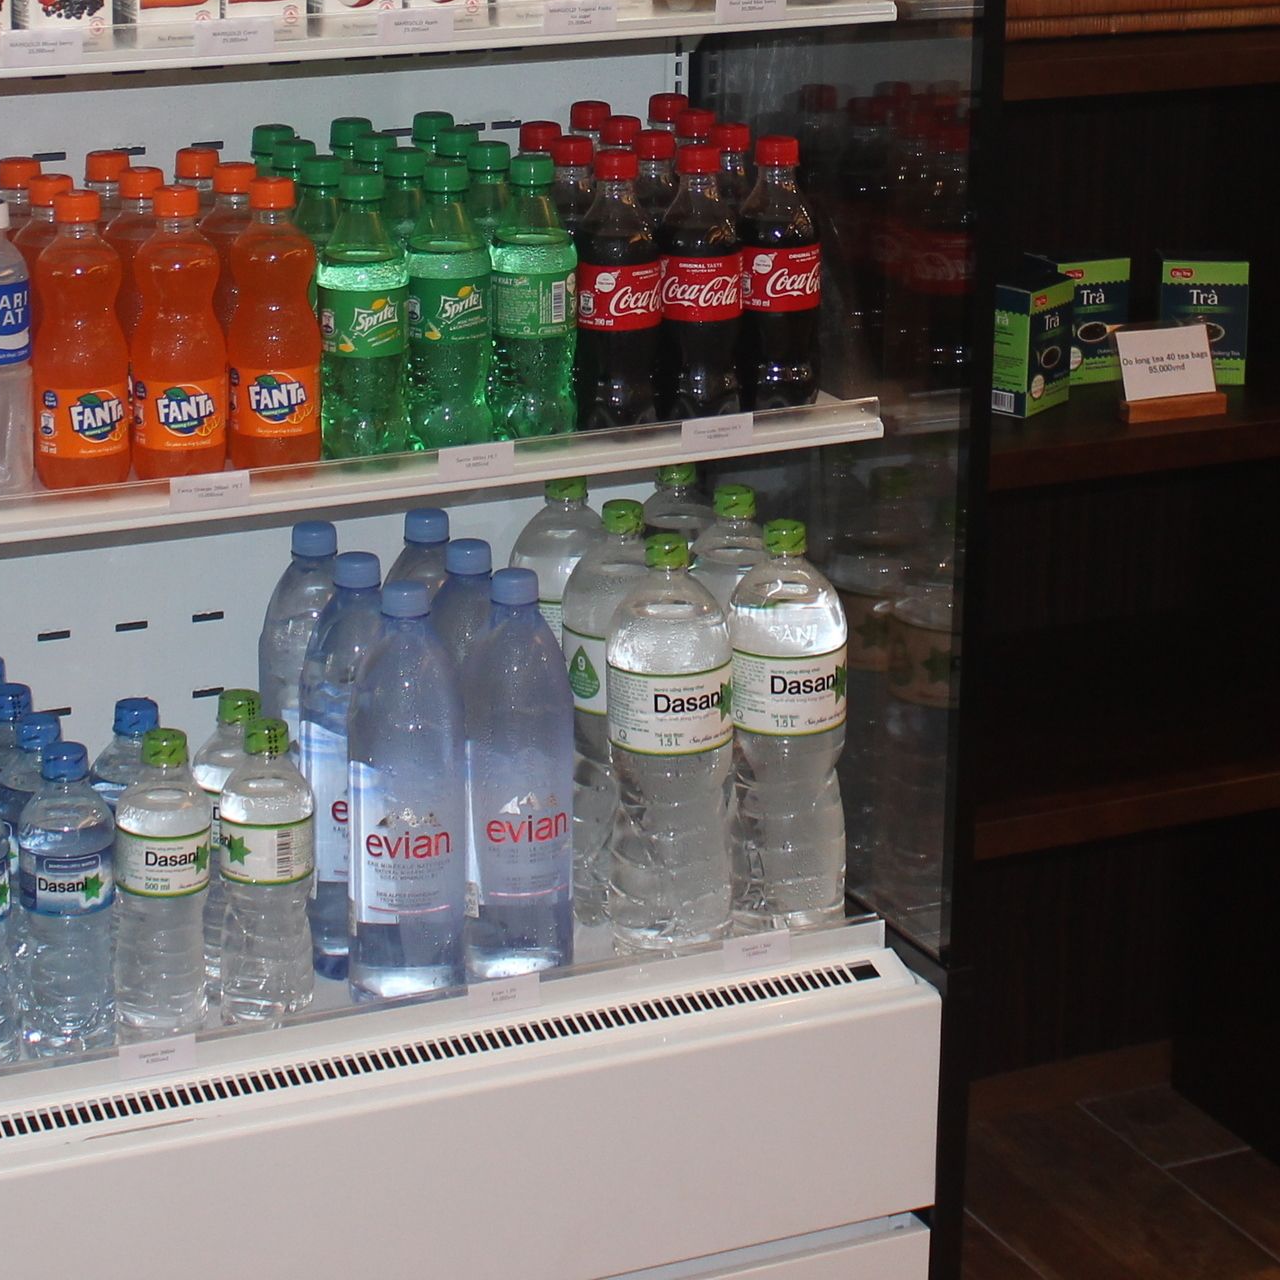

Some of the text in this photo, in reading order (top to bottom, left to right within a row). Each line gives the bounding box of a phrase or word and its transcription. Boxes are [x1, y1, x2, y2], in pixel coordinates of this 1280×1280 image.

[662, 275, 738, 308] Coca-Cola
[1080, 288, 1106, 306] Trà
[1189, 288, 1219, 306] Trà
[442, 293, 480, 319] Sprite
[356, 304, 395, 332] Sprite
[1044, 312, 1060, 331] Trà
[1152, 355, 1165, 364] tea
[1166, 354, 1176, 362] 40
[1177, 352, 1190, 362] tea
[1191, 350, 1208, 361] bags
[248, 382, 307, 410] FANTA
[70, 400, 125, 431] FANTA
[156, 394, 214, 423] FANTA
[770, 673, 838, 696] Dasani
[654, 690, 723, 714] Dasani
[775, 720, 788, 728] 1.5
[660, 738, 672, 747] 1.5
[486, 810, 568, 845] evian
[365, 830, 452, 860] evian
[145, 850, 200, 868] Dasani
[38, 878, 88, 893] Dasani
[144, 882, 170, 891] 500 ml
